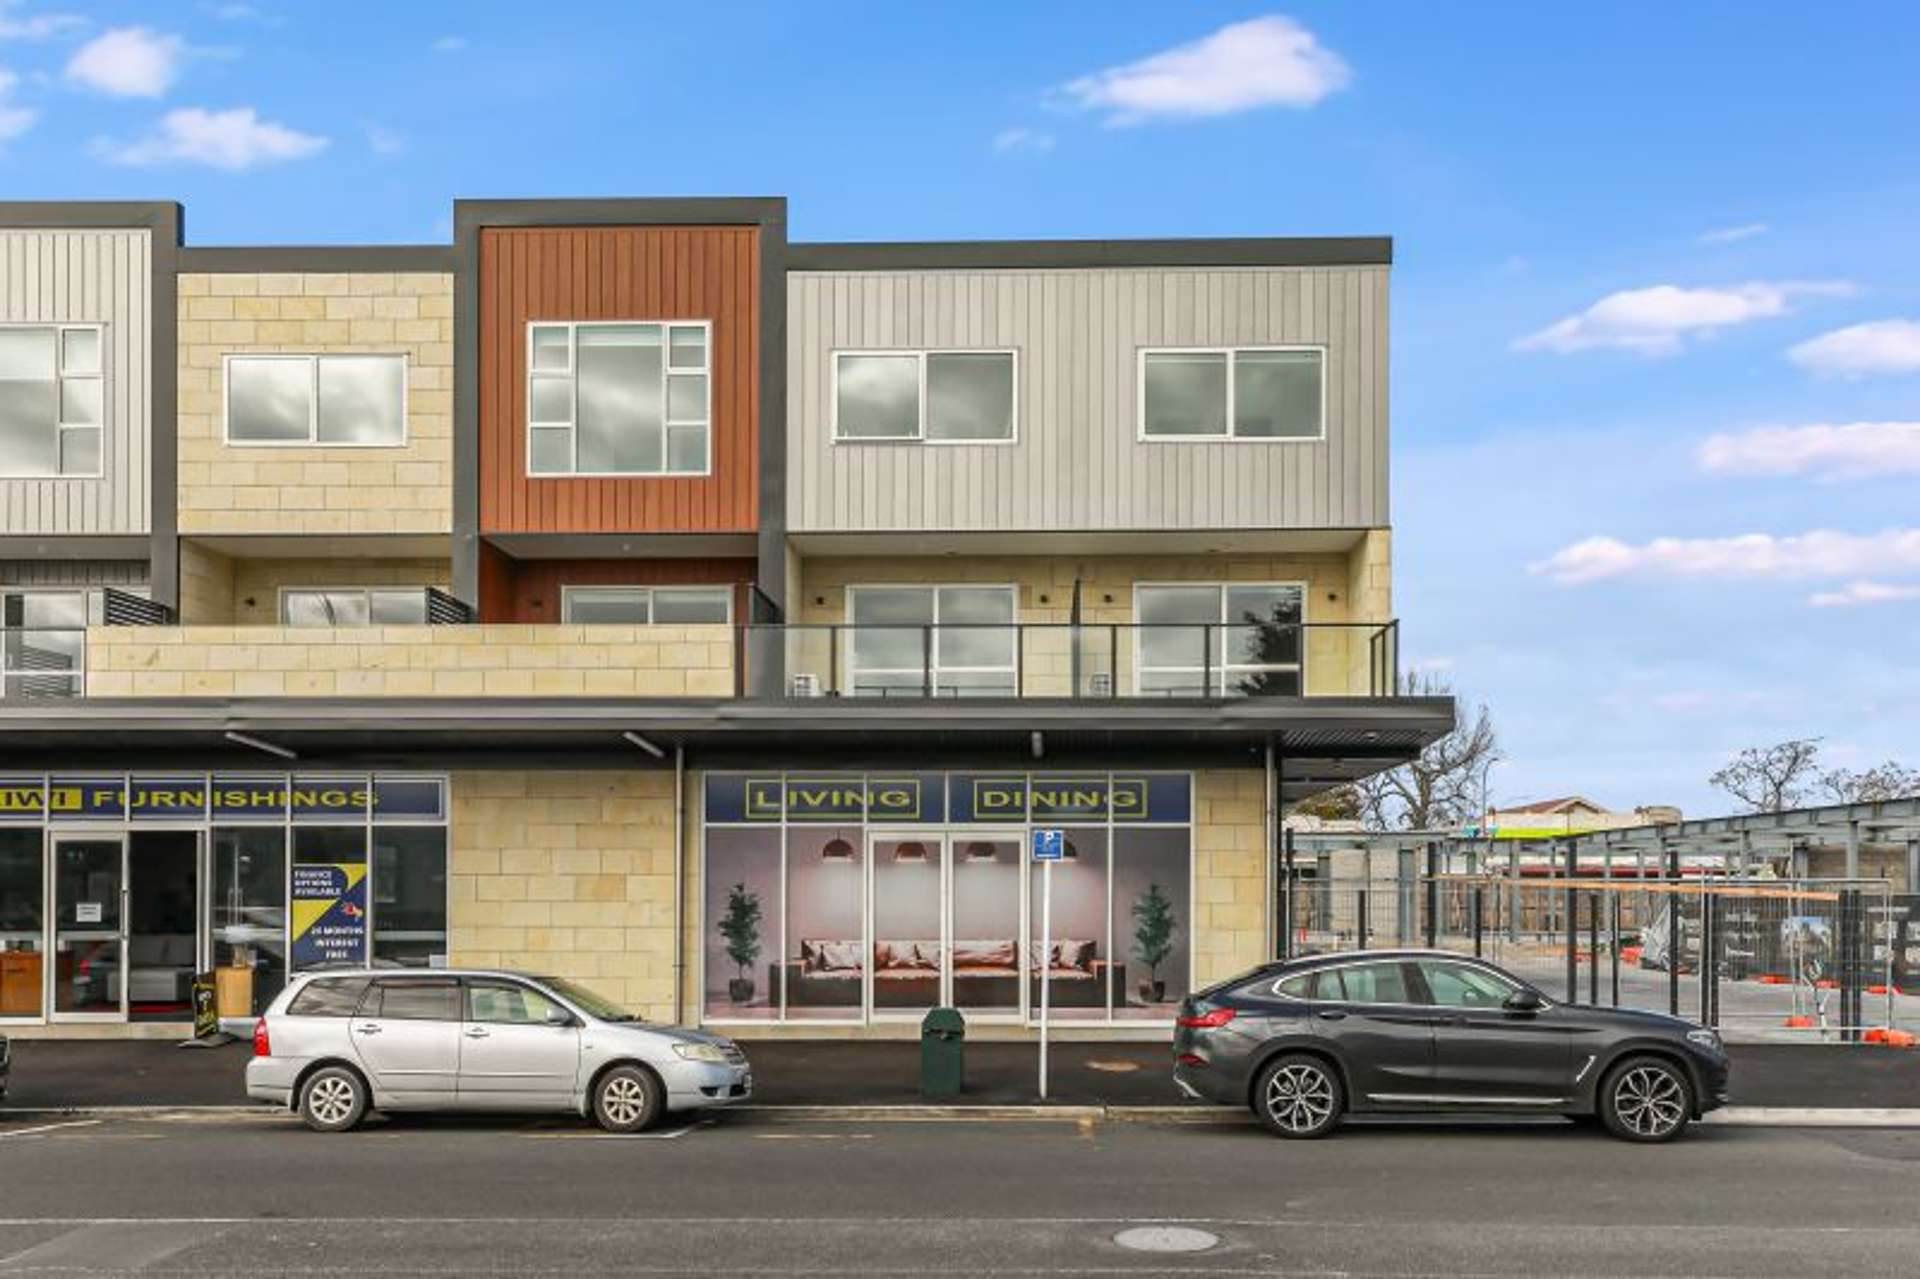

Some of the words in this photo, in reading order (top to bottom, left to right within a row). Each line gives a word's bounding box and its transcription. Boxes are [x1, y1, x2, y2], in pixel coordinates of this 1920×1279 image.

[93, 790, 379, 807] FURNISHINGS
[756, 790, 911, 808] LIVING
[983, 790, 1137, 808] DINING
[315, 938, 359, 947] INTEREST
[325, 950, 348, 959] FREE
